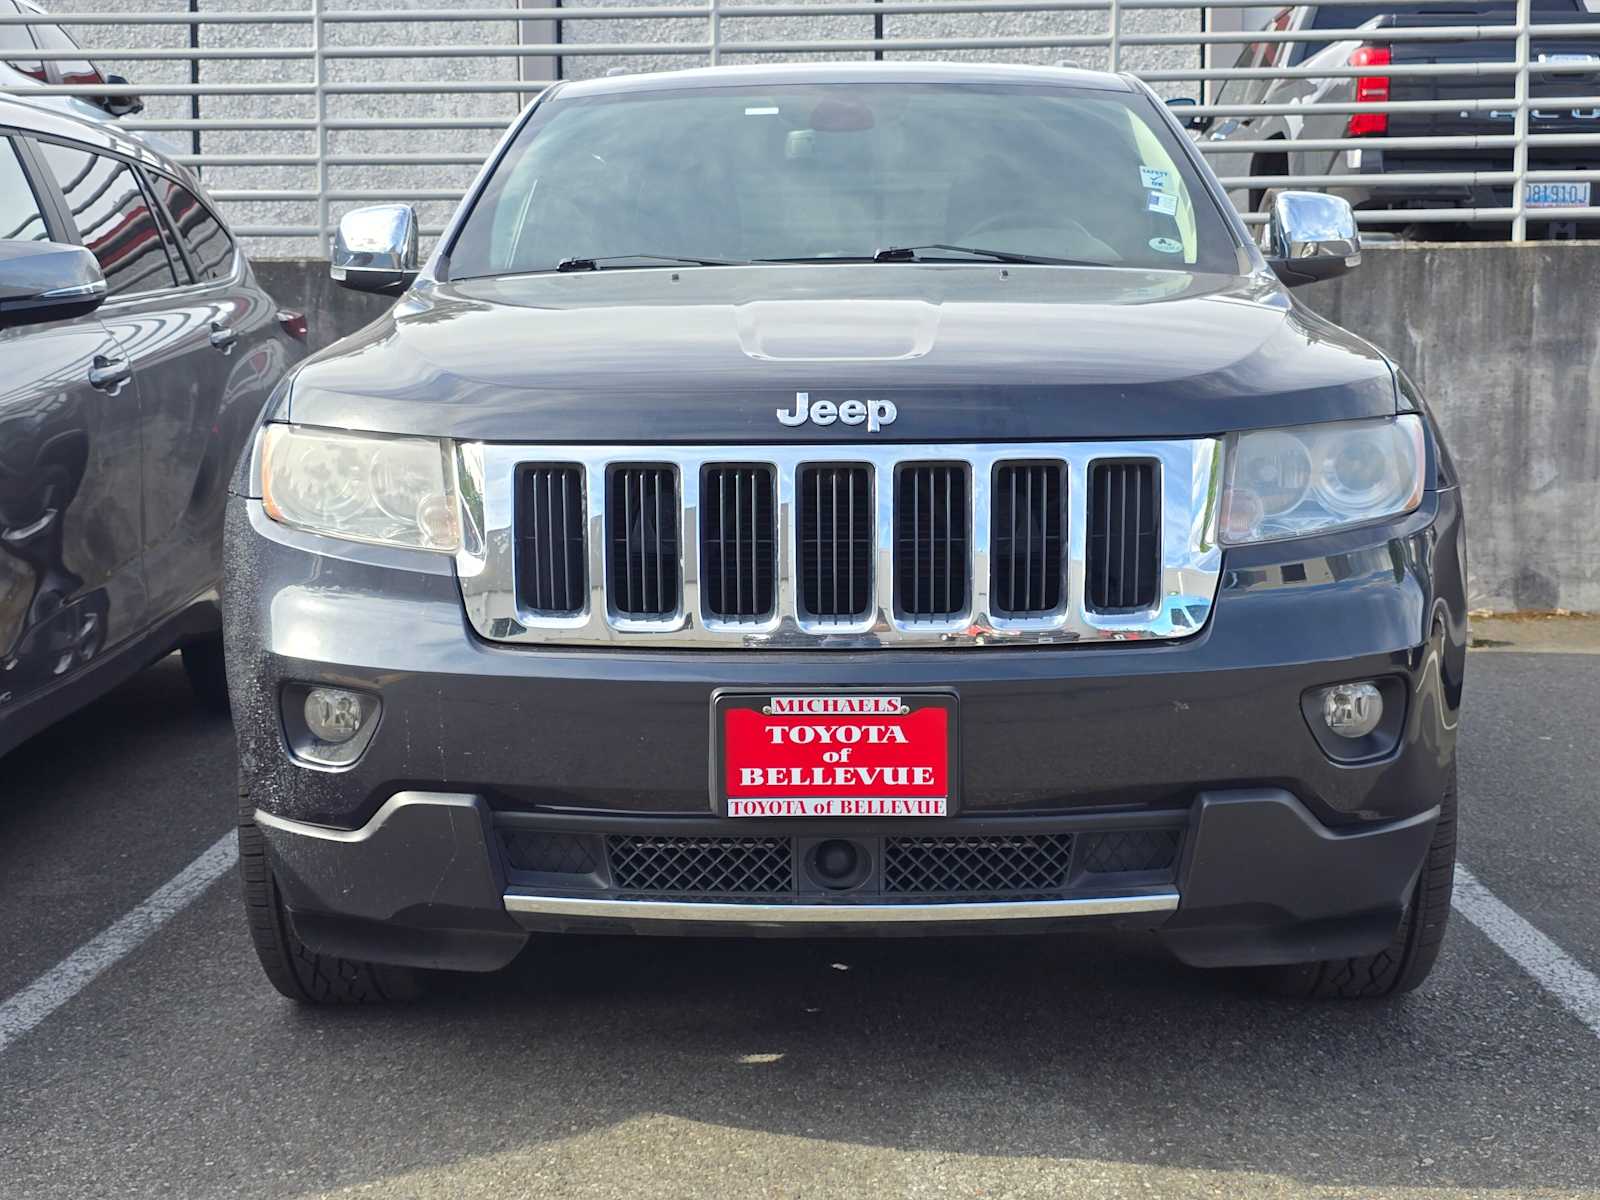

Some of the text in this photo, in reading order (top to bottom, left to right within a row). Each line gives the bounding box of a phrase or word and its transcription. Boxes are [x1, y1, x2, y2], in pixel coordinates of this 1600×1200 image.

[776, 392, 898, 433] Jeep
[774, 698, 900, 713] MICHAELS
[764, 725, 910, 745] TOYOTA
[822, 748, 853, 764] of
[739, 767, 936, 787] BELLEVUE
[730, 799, 946, 816] TOYOTA of BELLEVUE
